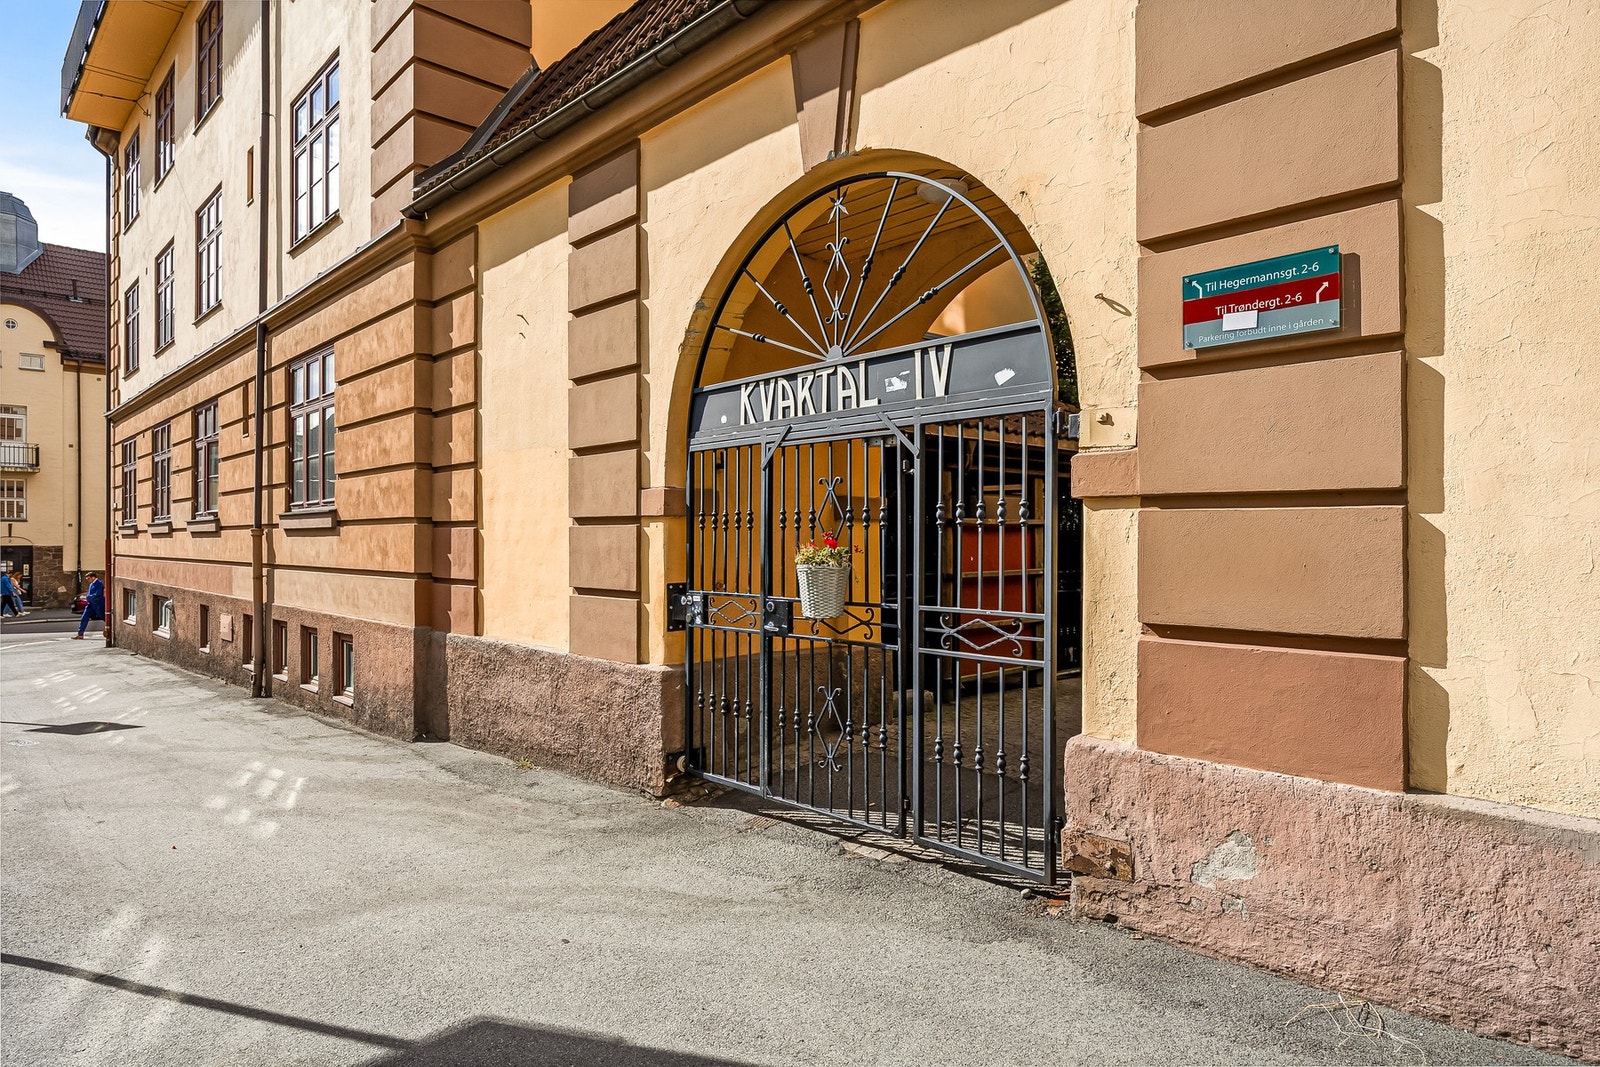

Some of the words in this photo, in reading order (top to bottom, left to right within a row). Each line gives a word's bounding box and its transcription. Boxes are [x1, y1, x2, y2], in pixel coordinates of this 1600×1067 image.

[1205, 282, 1217, 292] Til
[1219, 267, 1300, 290] Hegermannsgt.
[1302, 262, 1319, 274] 2-6
[1215, 306, 1227, 316] Til
[1228, 299, 1283, 314] Trøndergt.
[1285, 292, 1302, 305] 2-6
[1198, 331, 1235, 343] Parkering
[1236, 327, 1267, 338] forbudt
[1268, 324, 1287, 334] inne
[1293, 317, 1324, 332] gården
[740, 360, 879, 425] KVARTAL
[914, 343, 952, 400] IV
